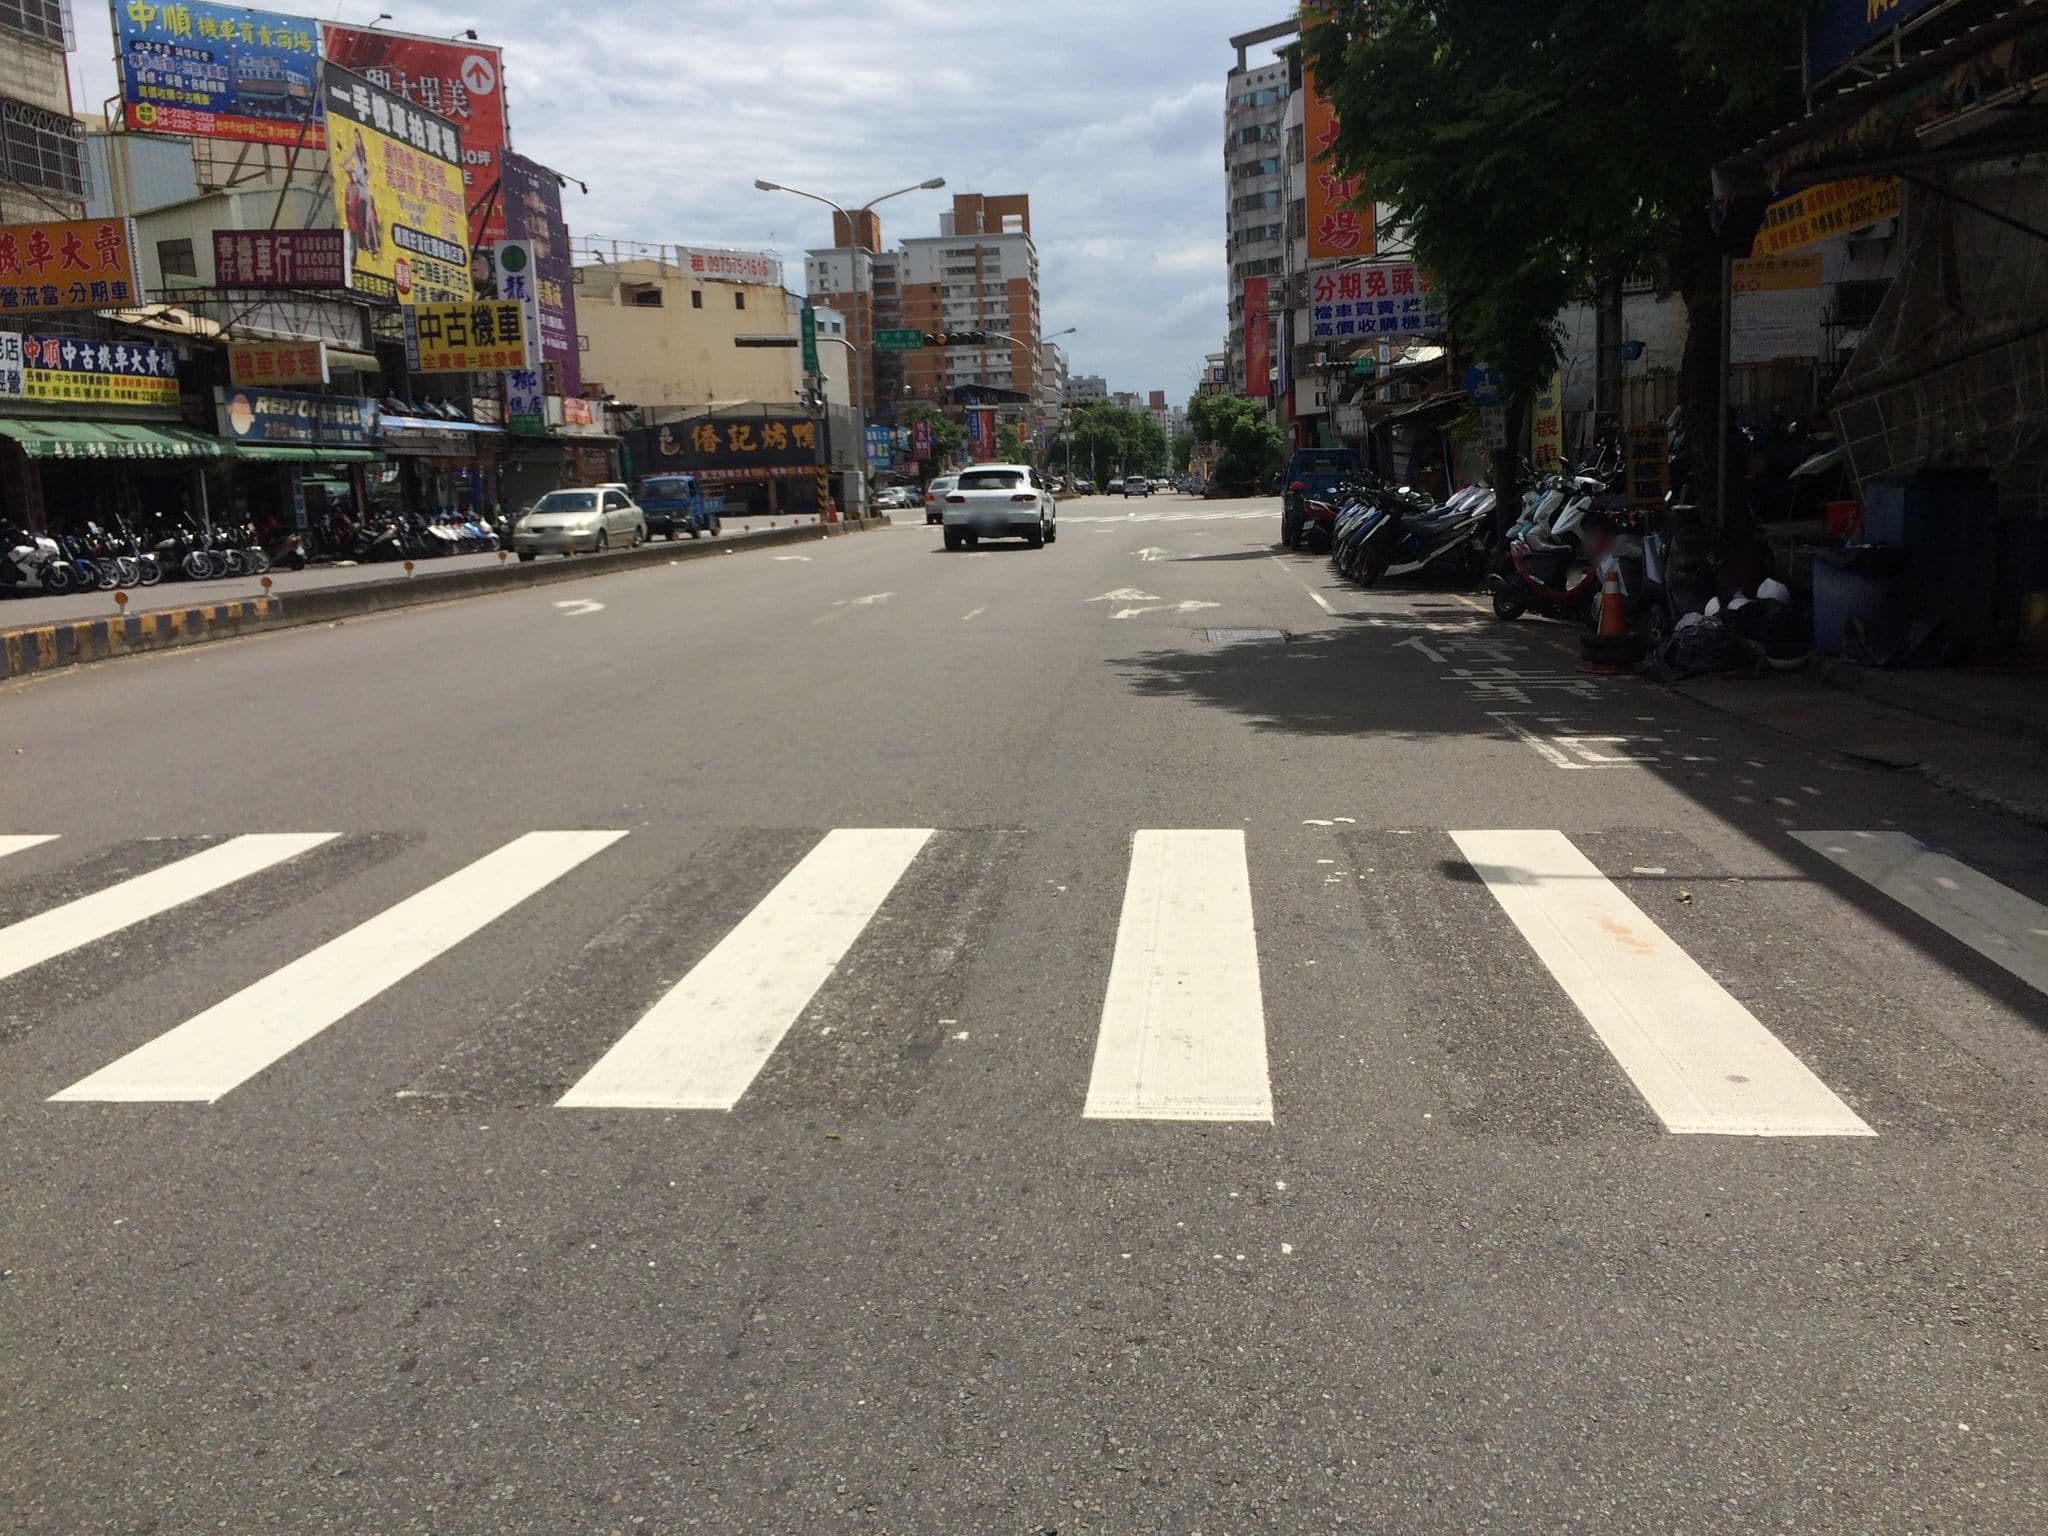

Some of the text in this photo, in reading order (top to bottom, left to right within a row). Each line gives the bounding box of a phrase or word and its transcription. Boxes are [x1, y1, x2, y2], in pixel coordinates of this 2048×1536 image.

[237, 235, 292, 283] 機車行
[689, 254, 704, 272] 租
[418, 304, 521, 351] 中古機車
[235, 349, 318, 380] 機車修理
